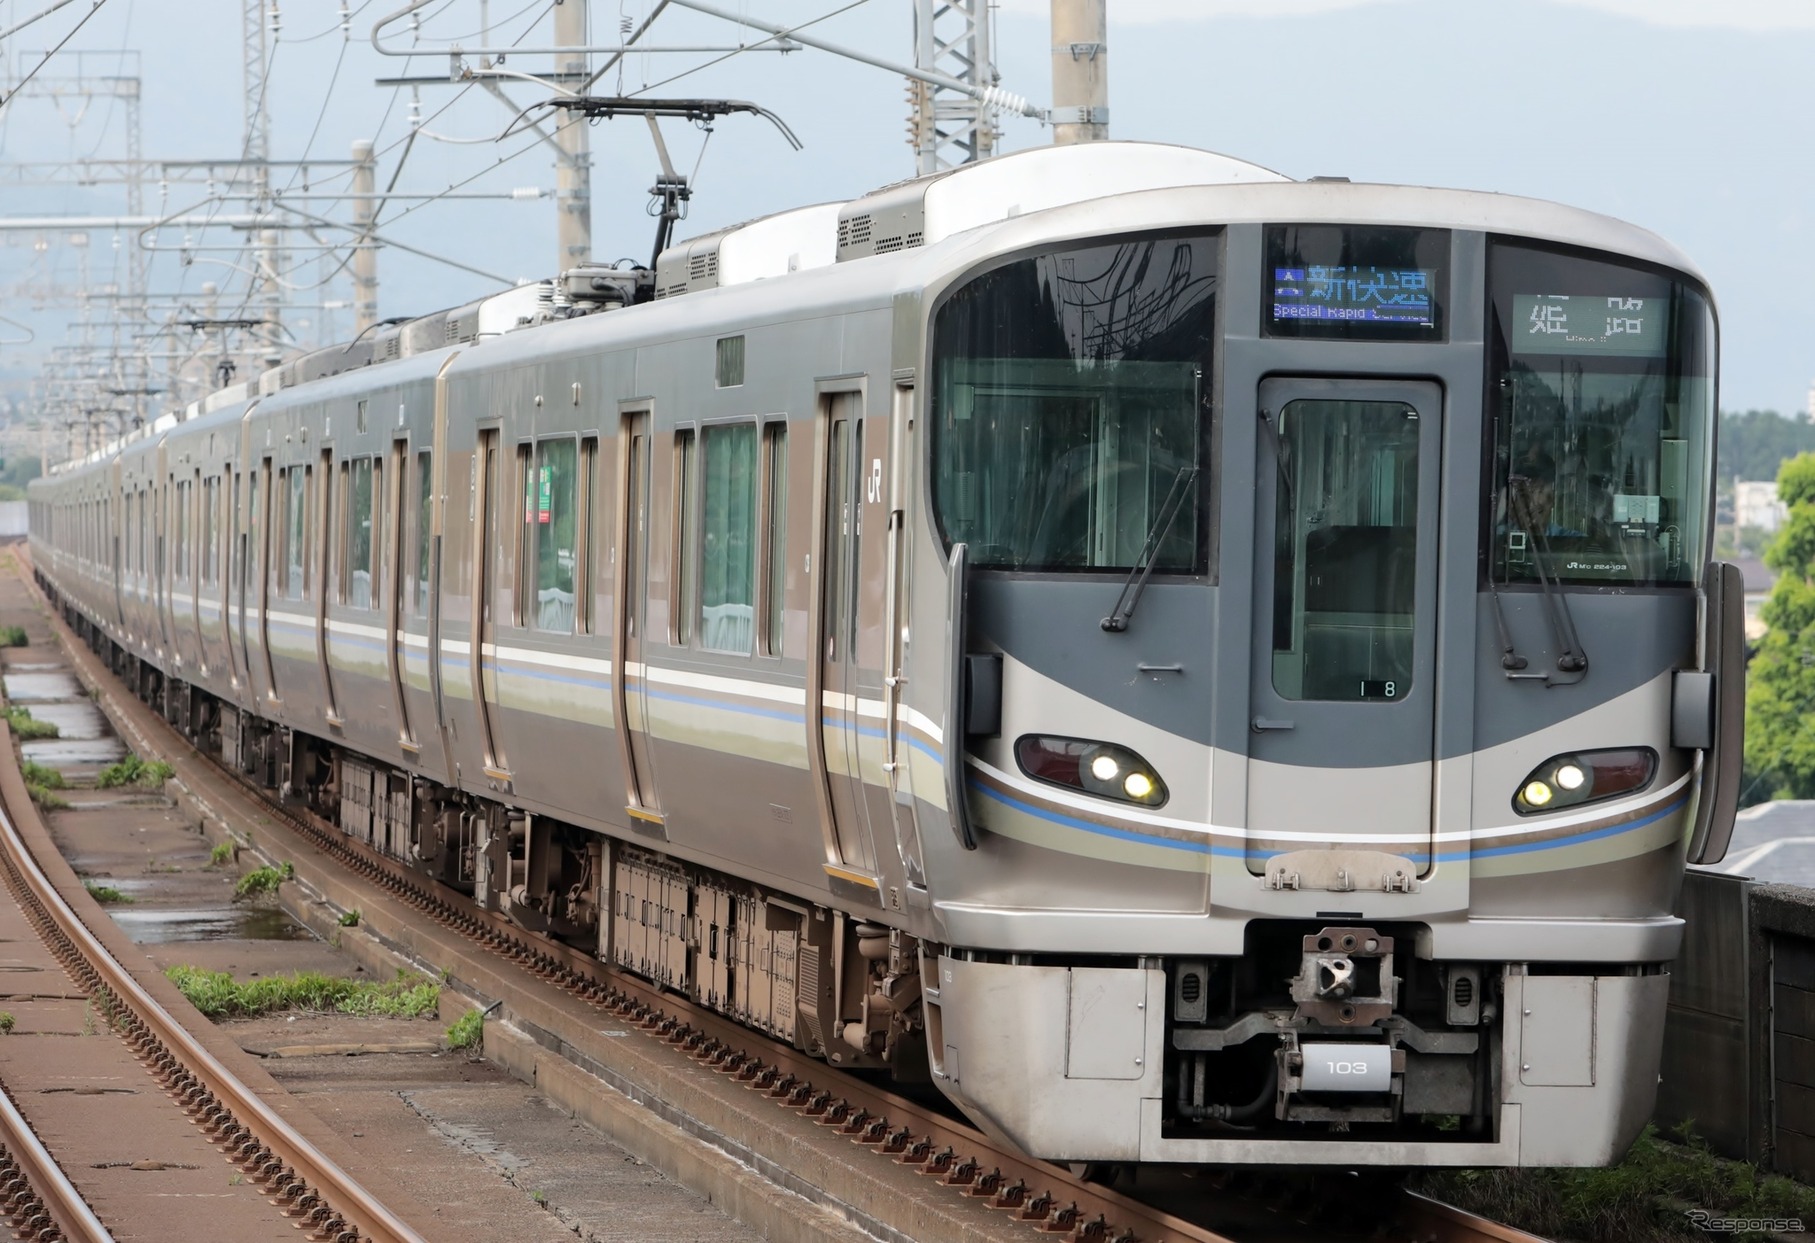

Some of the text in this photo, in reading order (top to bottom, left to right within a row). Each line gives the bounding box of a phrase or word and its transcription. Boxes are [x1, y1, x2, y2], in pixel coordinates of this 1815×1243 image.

[1274, 303, 1321, 319] Special
[868, 458, 881, 504] JR
[1566, 561, 1578, 569] JR
[1384, 681, 1395, 697] 8
[1327, 1061, 1368, 1075] 103
